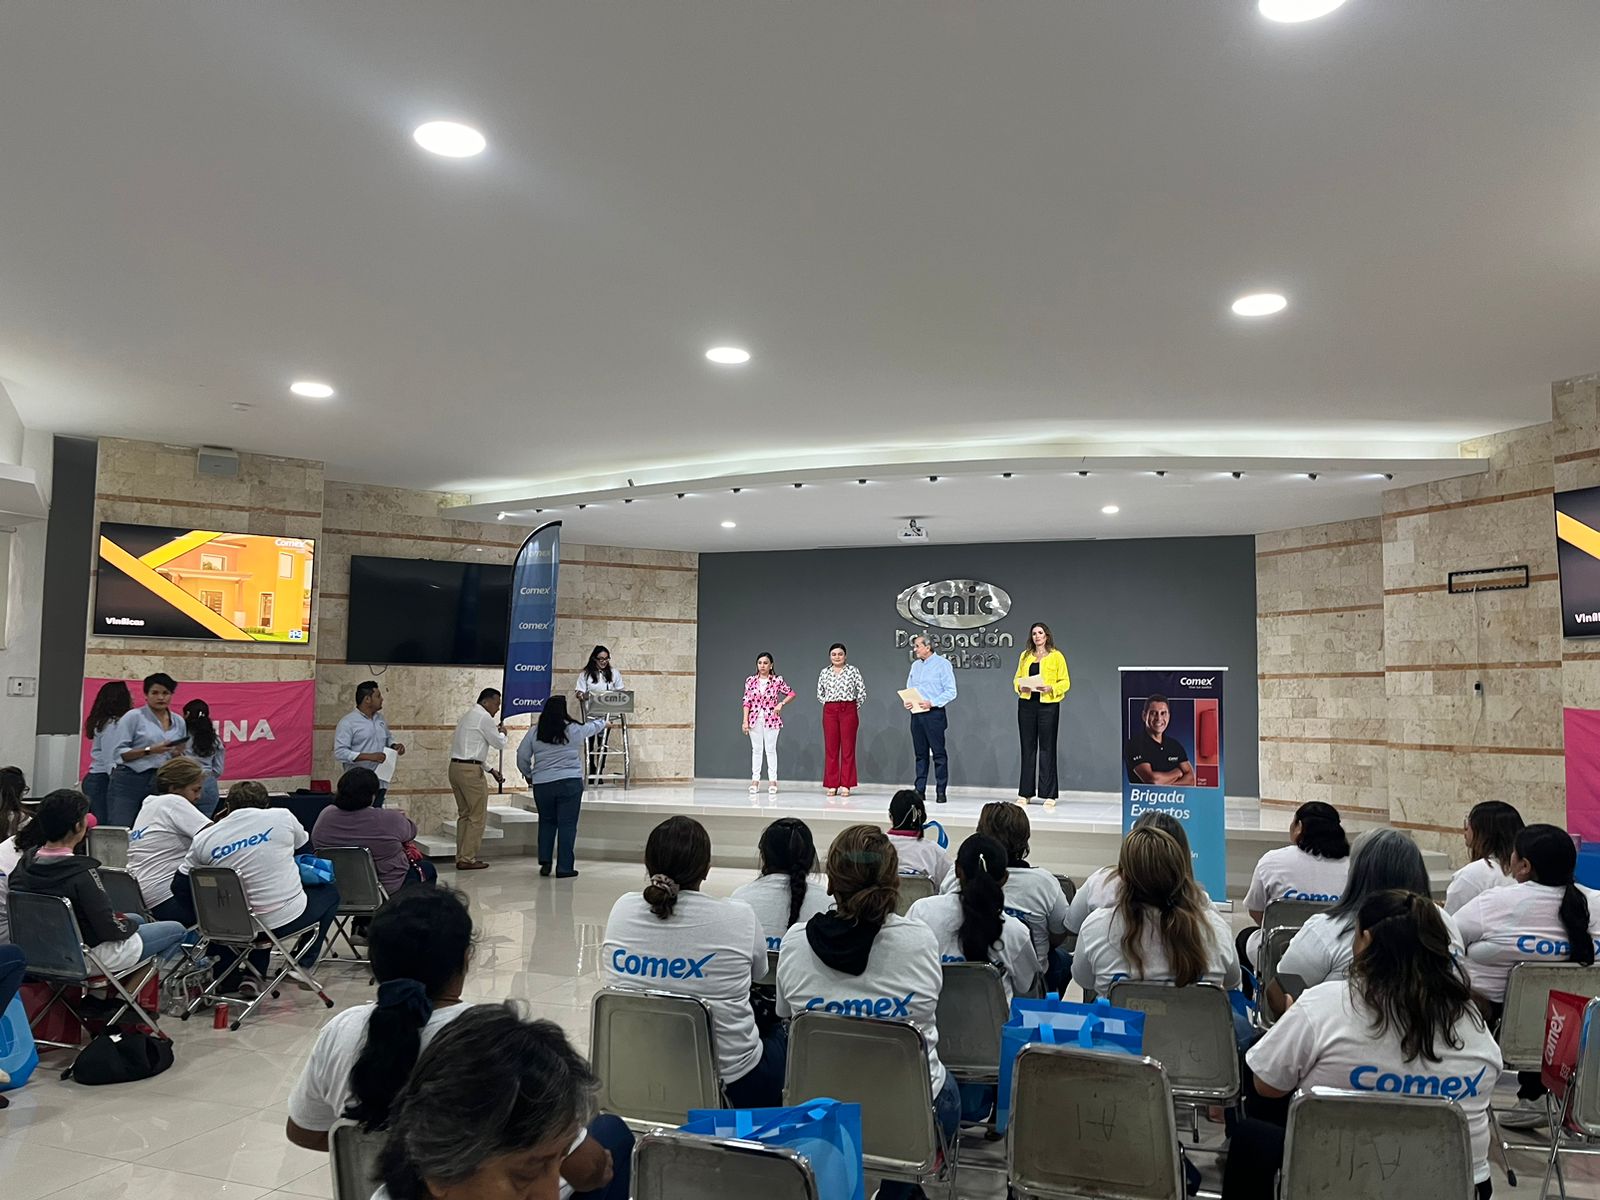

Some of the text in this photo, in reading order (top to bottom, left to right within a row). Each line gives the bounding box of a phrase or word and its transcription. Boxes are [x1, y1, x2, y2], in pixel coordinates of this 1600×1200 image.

[520, 586, 551, 596] Comex
[920, 585, 993, 616] cmic
[518, 622, 549, 631] Comex
[514, 663, 547, 672] Comex
[1180, 677, 1215, 686] Comex
[512, 698, 545, 707] Comex
[1130, 788, 1186, 805] Brigada
[211, 827, 275, 859] Comex
[612, 950, 718, 980] Comex
[805, 991, 916, 1018] Comex
[1544, 1003, 1566, 1066] Comex
[1349, 1065, 1487, 1101] Comex
